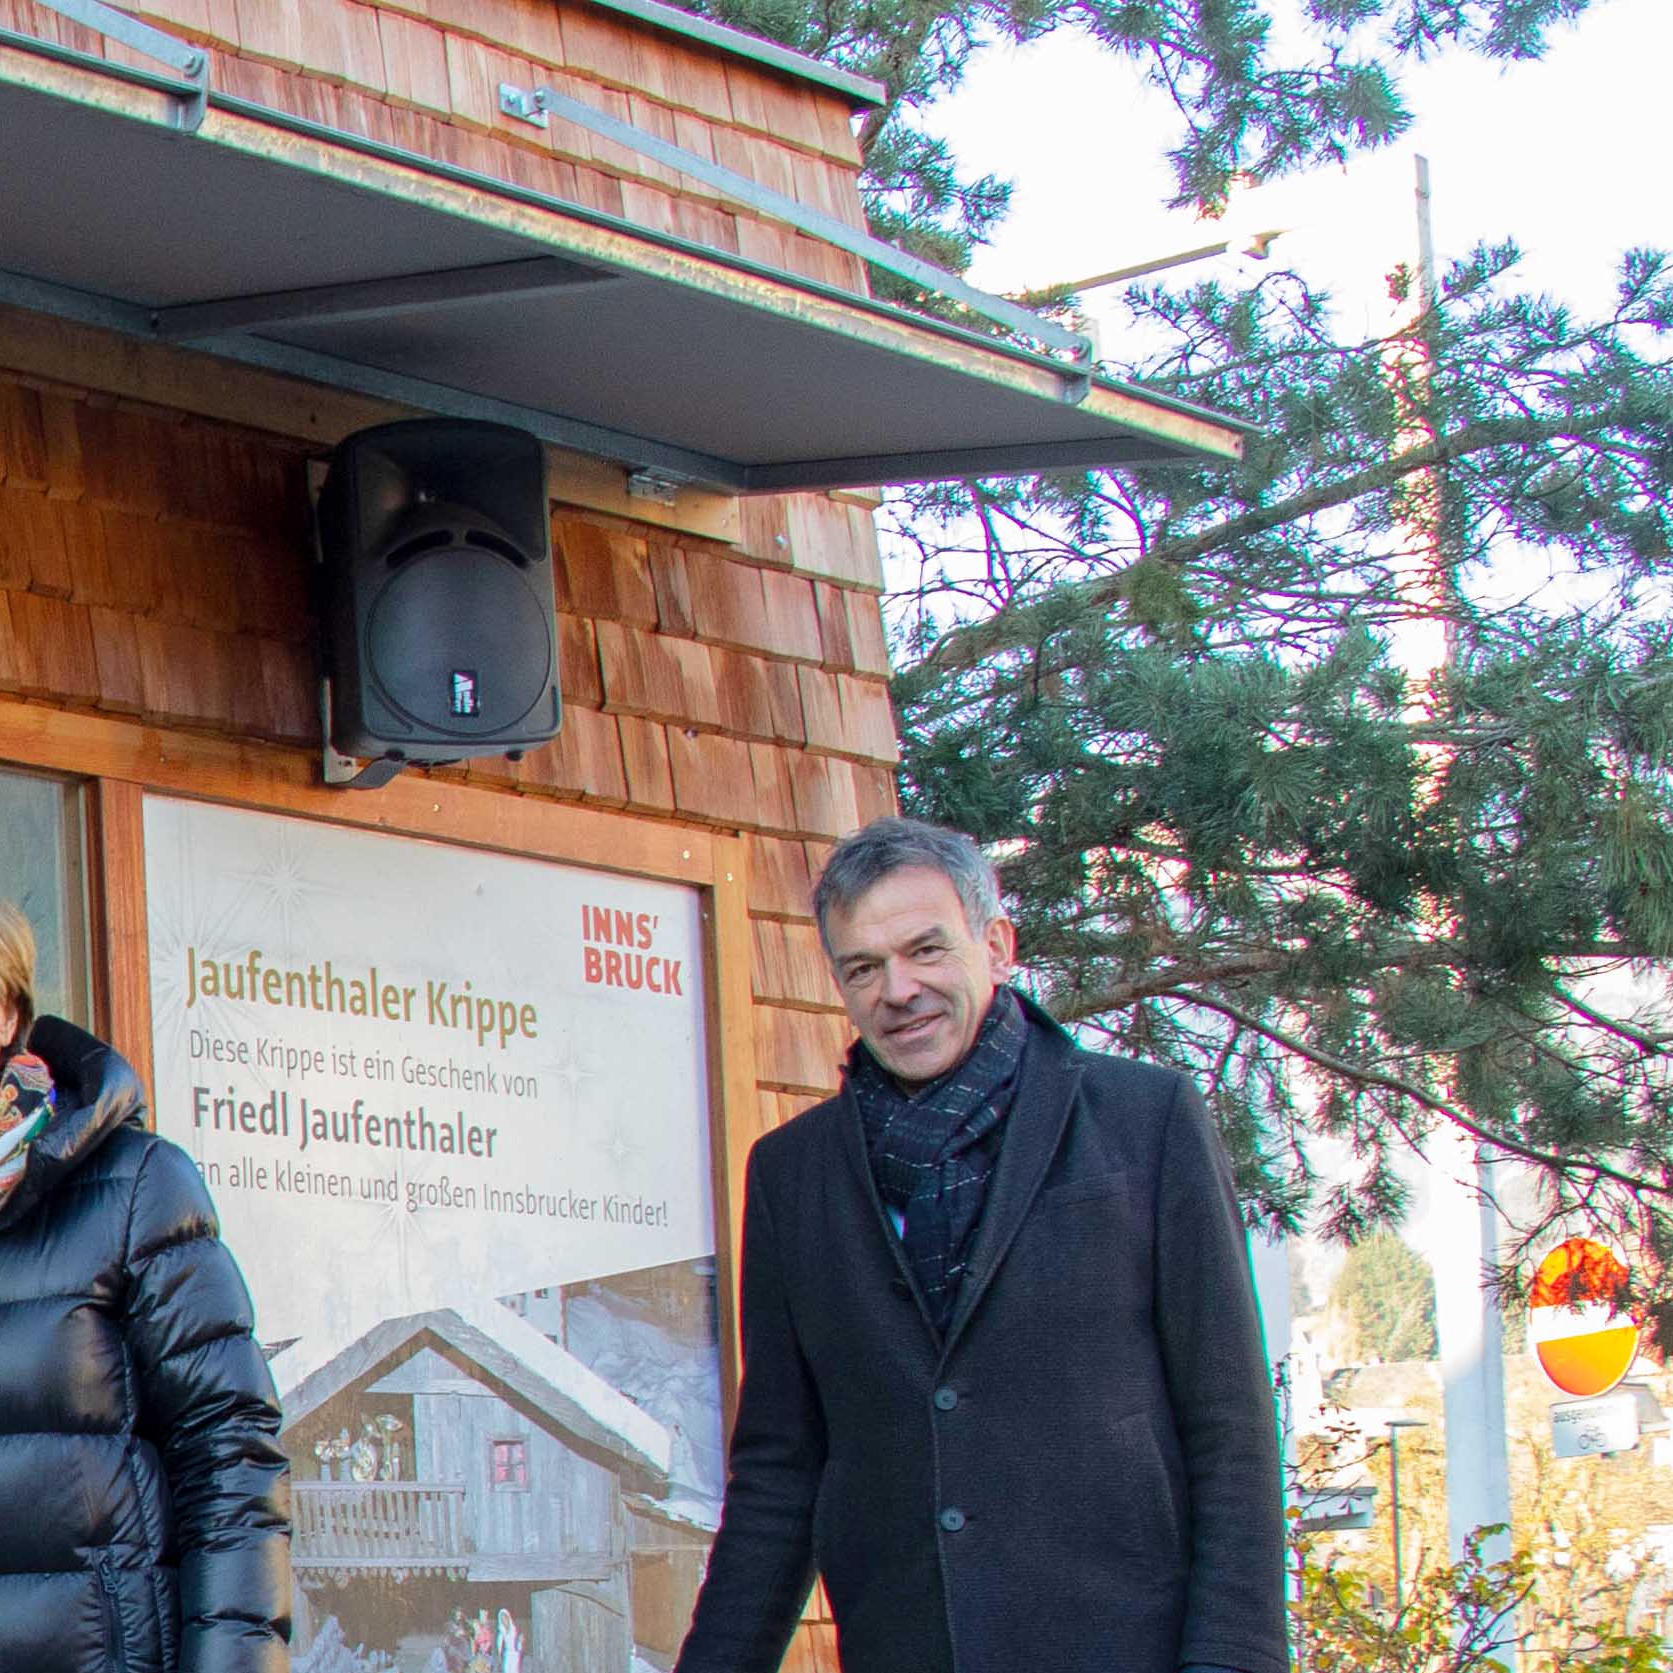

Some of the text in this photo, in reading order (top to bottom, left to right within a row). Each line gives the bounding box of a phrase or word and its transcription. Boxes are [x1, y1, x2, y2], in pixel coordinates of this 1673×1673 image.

[186, 947, 538, 1049] Jaufenthaler Krippe
[584, 946, 683, 996] BRUCK
[190, 1029, 538, 1099] Diese Krippe ist ein Geschenk von
[193, 1085, 498, 1158] Friedl Jaufenthaler
[229, 1156, 267, 1190] alle
[275, 1159, 352, 1197] kleinen
[359, 1168, 398, 1201] und
[405, 1175, 476, 1213] großen
[483, 1183, 598, 1221] Innsbrucker
[603, 1194, 669, 1228] Kinder!
